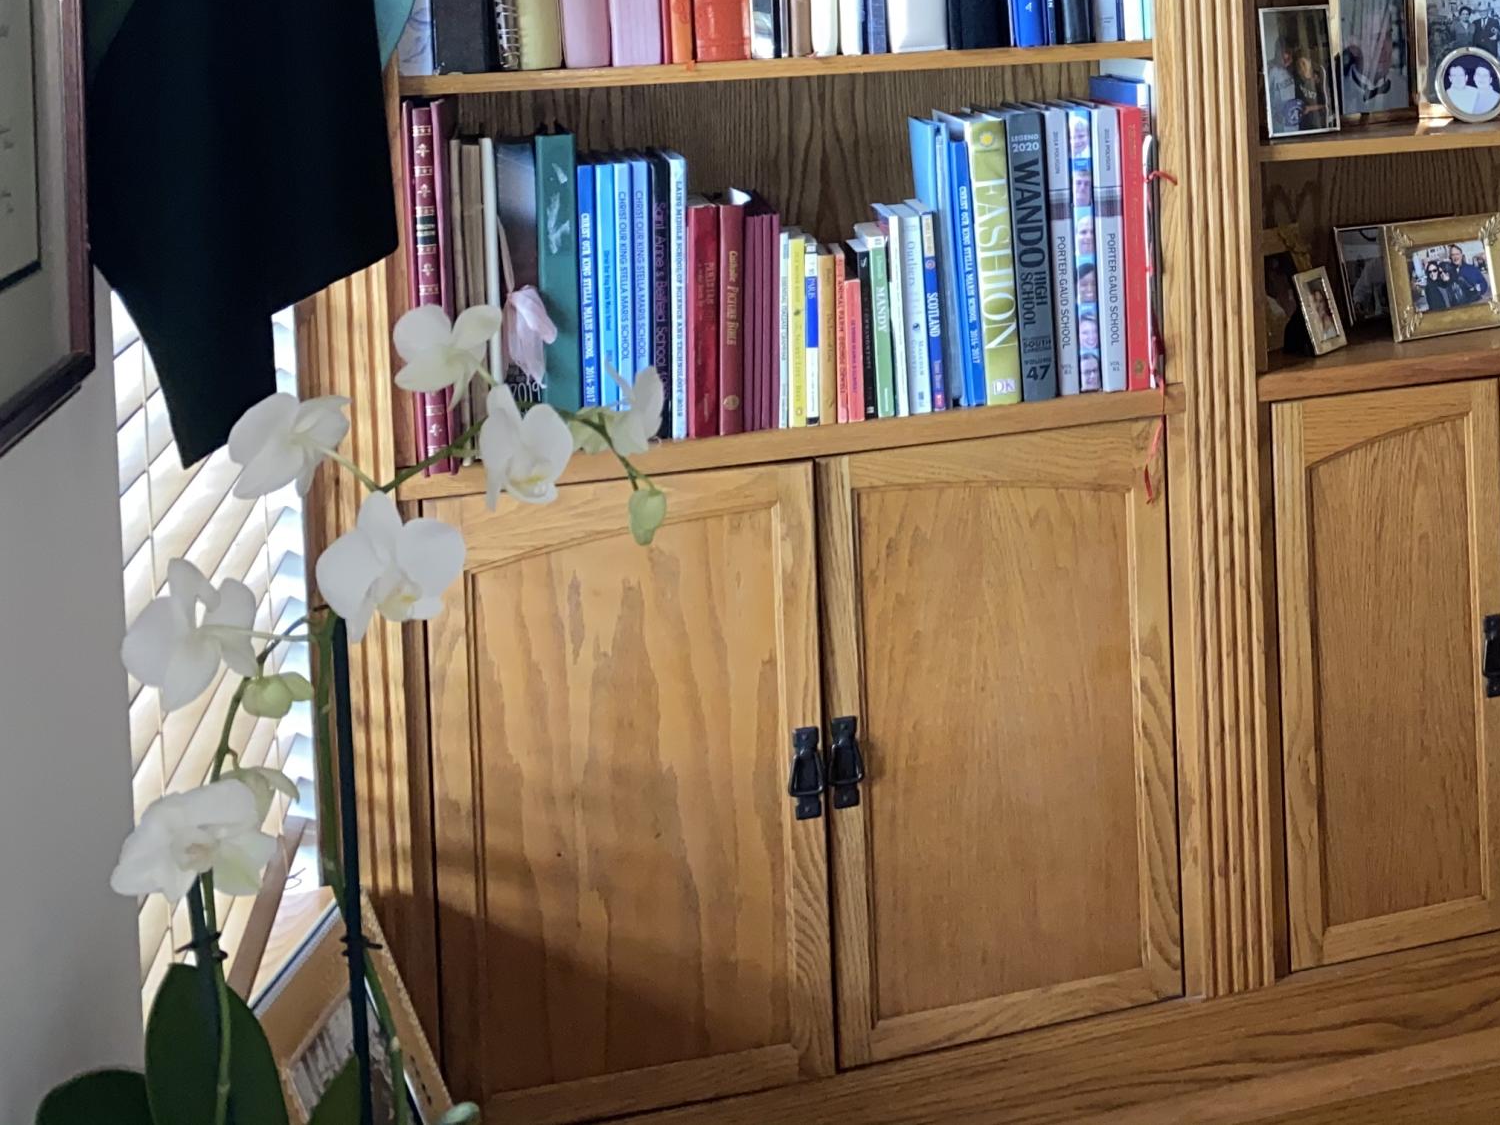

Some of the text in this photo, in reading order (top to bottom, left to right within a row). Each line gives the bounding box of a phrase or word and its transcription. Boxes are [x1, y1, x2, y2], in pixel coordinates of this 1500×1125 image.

[1011, 134, 1039, 142] LEGEND
[1012, 142, 1040, 152] 2020
[675, 180, 683, 207] LAING
[1013, 158, 1046, 269] WANDO
[654, 202, 667, 230] Saint
[675, 209, 683, 240] MIDDLE
[618, 192, 630, 361] CHRIST OUR KING STELLA MARIS SCHOOL
[635, 190, 647, 359] CHRIST OUR KING STELLA MARIS SCHOOL
[676, 273, 683, 284] OF
[906, 240, 917, 287] Outliers
[958, 185, 980, 364] CHRIST OUR KING STELLA MARIS SCHOOL 2016-2017
[972, 179, 1018, 349] FASHION
[580, 213, 595, 403] CHRIST OUR KING STELLA MARIS SCHOOL 2016-2017
[655, 281, 668, 322] Belfield
[726, 285, 740, 319] PICTURE
[807, 278, 816, 299] PARIS
[1019, 271, 1036, 329] SCHOOL
[1035, 271, 1048, 306] HIGH
[876, 286, 887, 333] MANDY
[927, 292, 940, 338] SCOTLAND
[1059, 309, 1071, 349] SCHOOL
[1109, 306, 1120, 346] SCHOOL
[656, 326, 669, 367] School
[1023, 340, 1051, 350] SOUTH
[676, 341, 684, 394] TECHNOLOGY
[992, 378, 1016, 395] DK
[1026, 365, 1050, 381] 47
